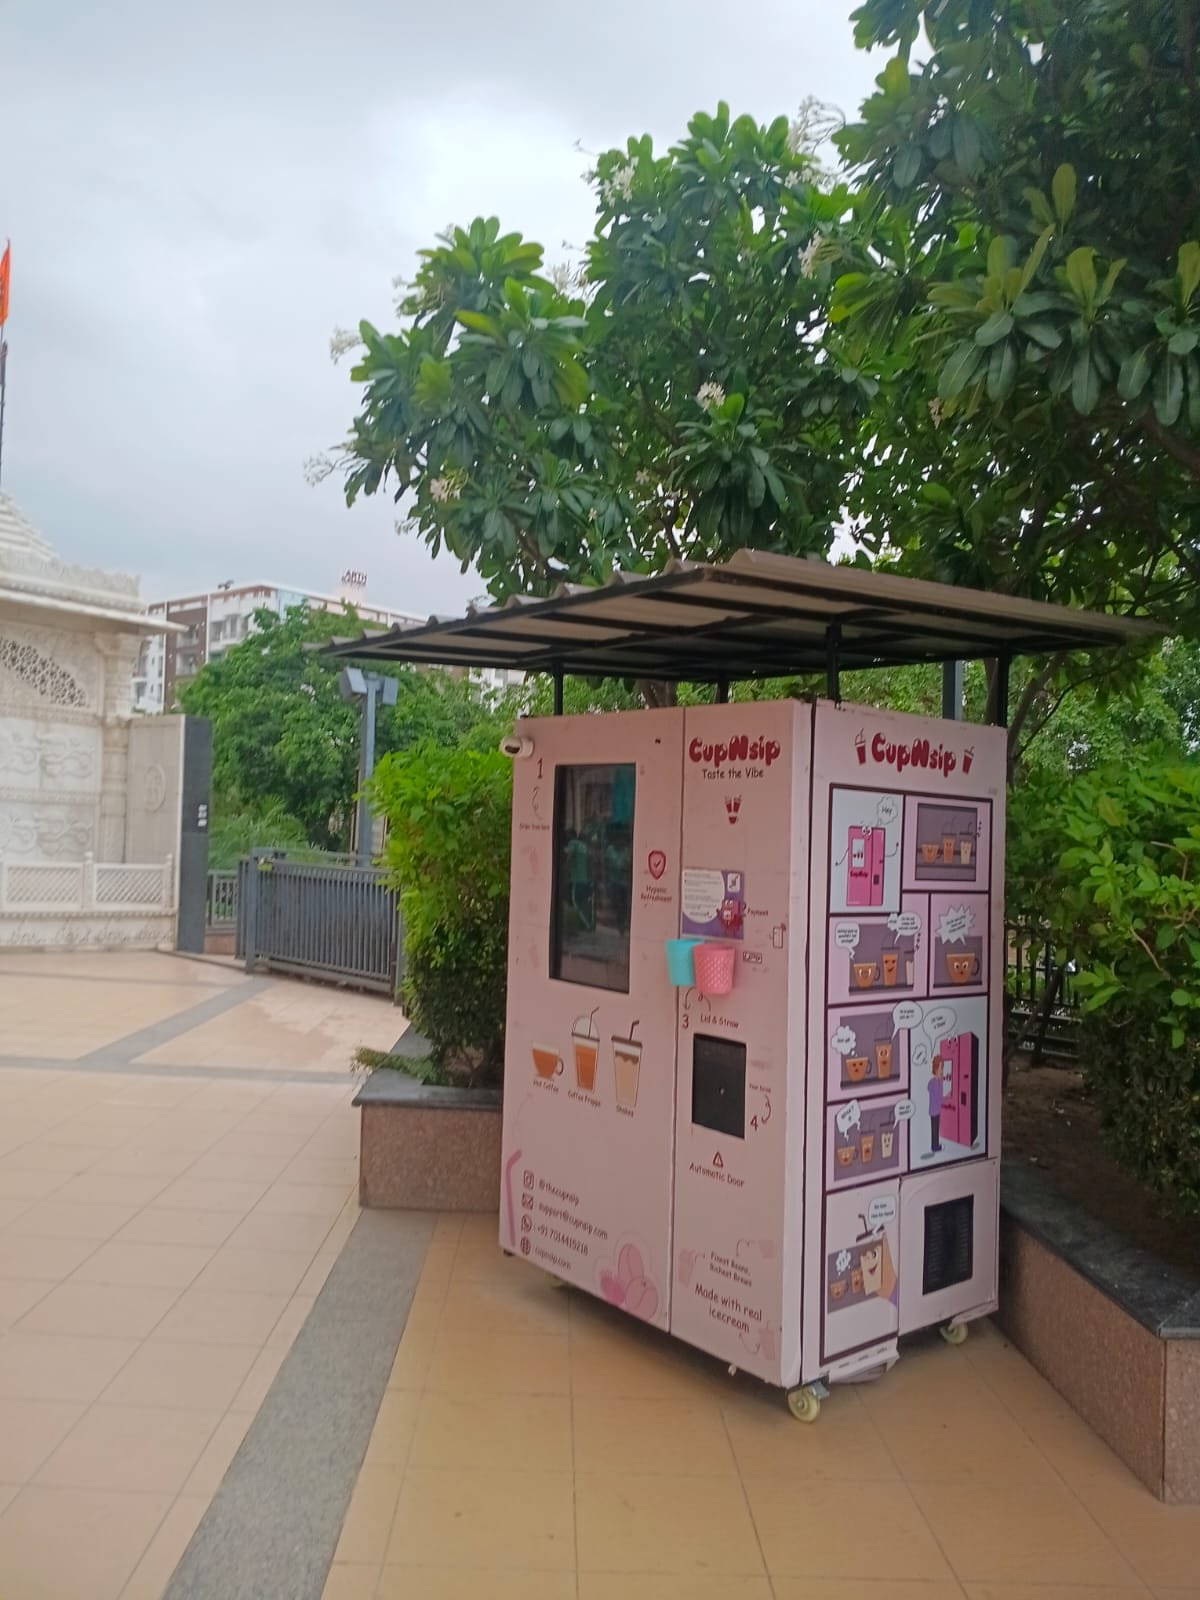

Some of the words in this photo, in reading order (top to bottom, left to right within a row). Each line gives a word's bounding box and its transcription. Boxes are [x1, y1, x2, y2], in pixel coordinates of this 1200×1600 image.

[537, 758, 543, 779] 1
[702, 769, 725, 780] Taste
[728, 767, 742, 779] the
[745, 766, 764, 779] Vibe
[682, 1014, 689, 1029] 3
[700, 1013, 711, 1023] Lid
[713, 1015, 718, 1024] &
[720, 1017, 739, 1029] Straw
[750, 1114, 758, 1131] 4
[689, 1162, 725, 1182] Automatic
[727, 1173, 745, 1187] Door
[695, 1282, 719, 1302] Made
[720, 1296, 741, 1313] with
[743, 1306, 762, 1322] real
